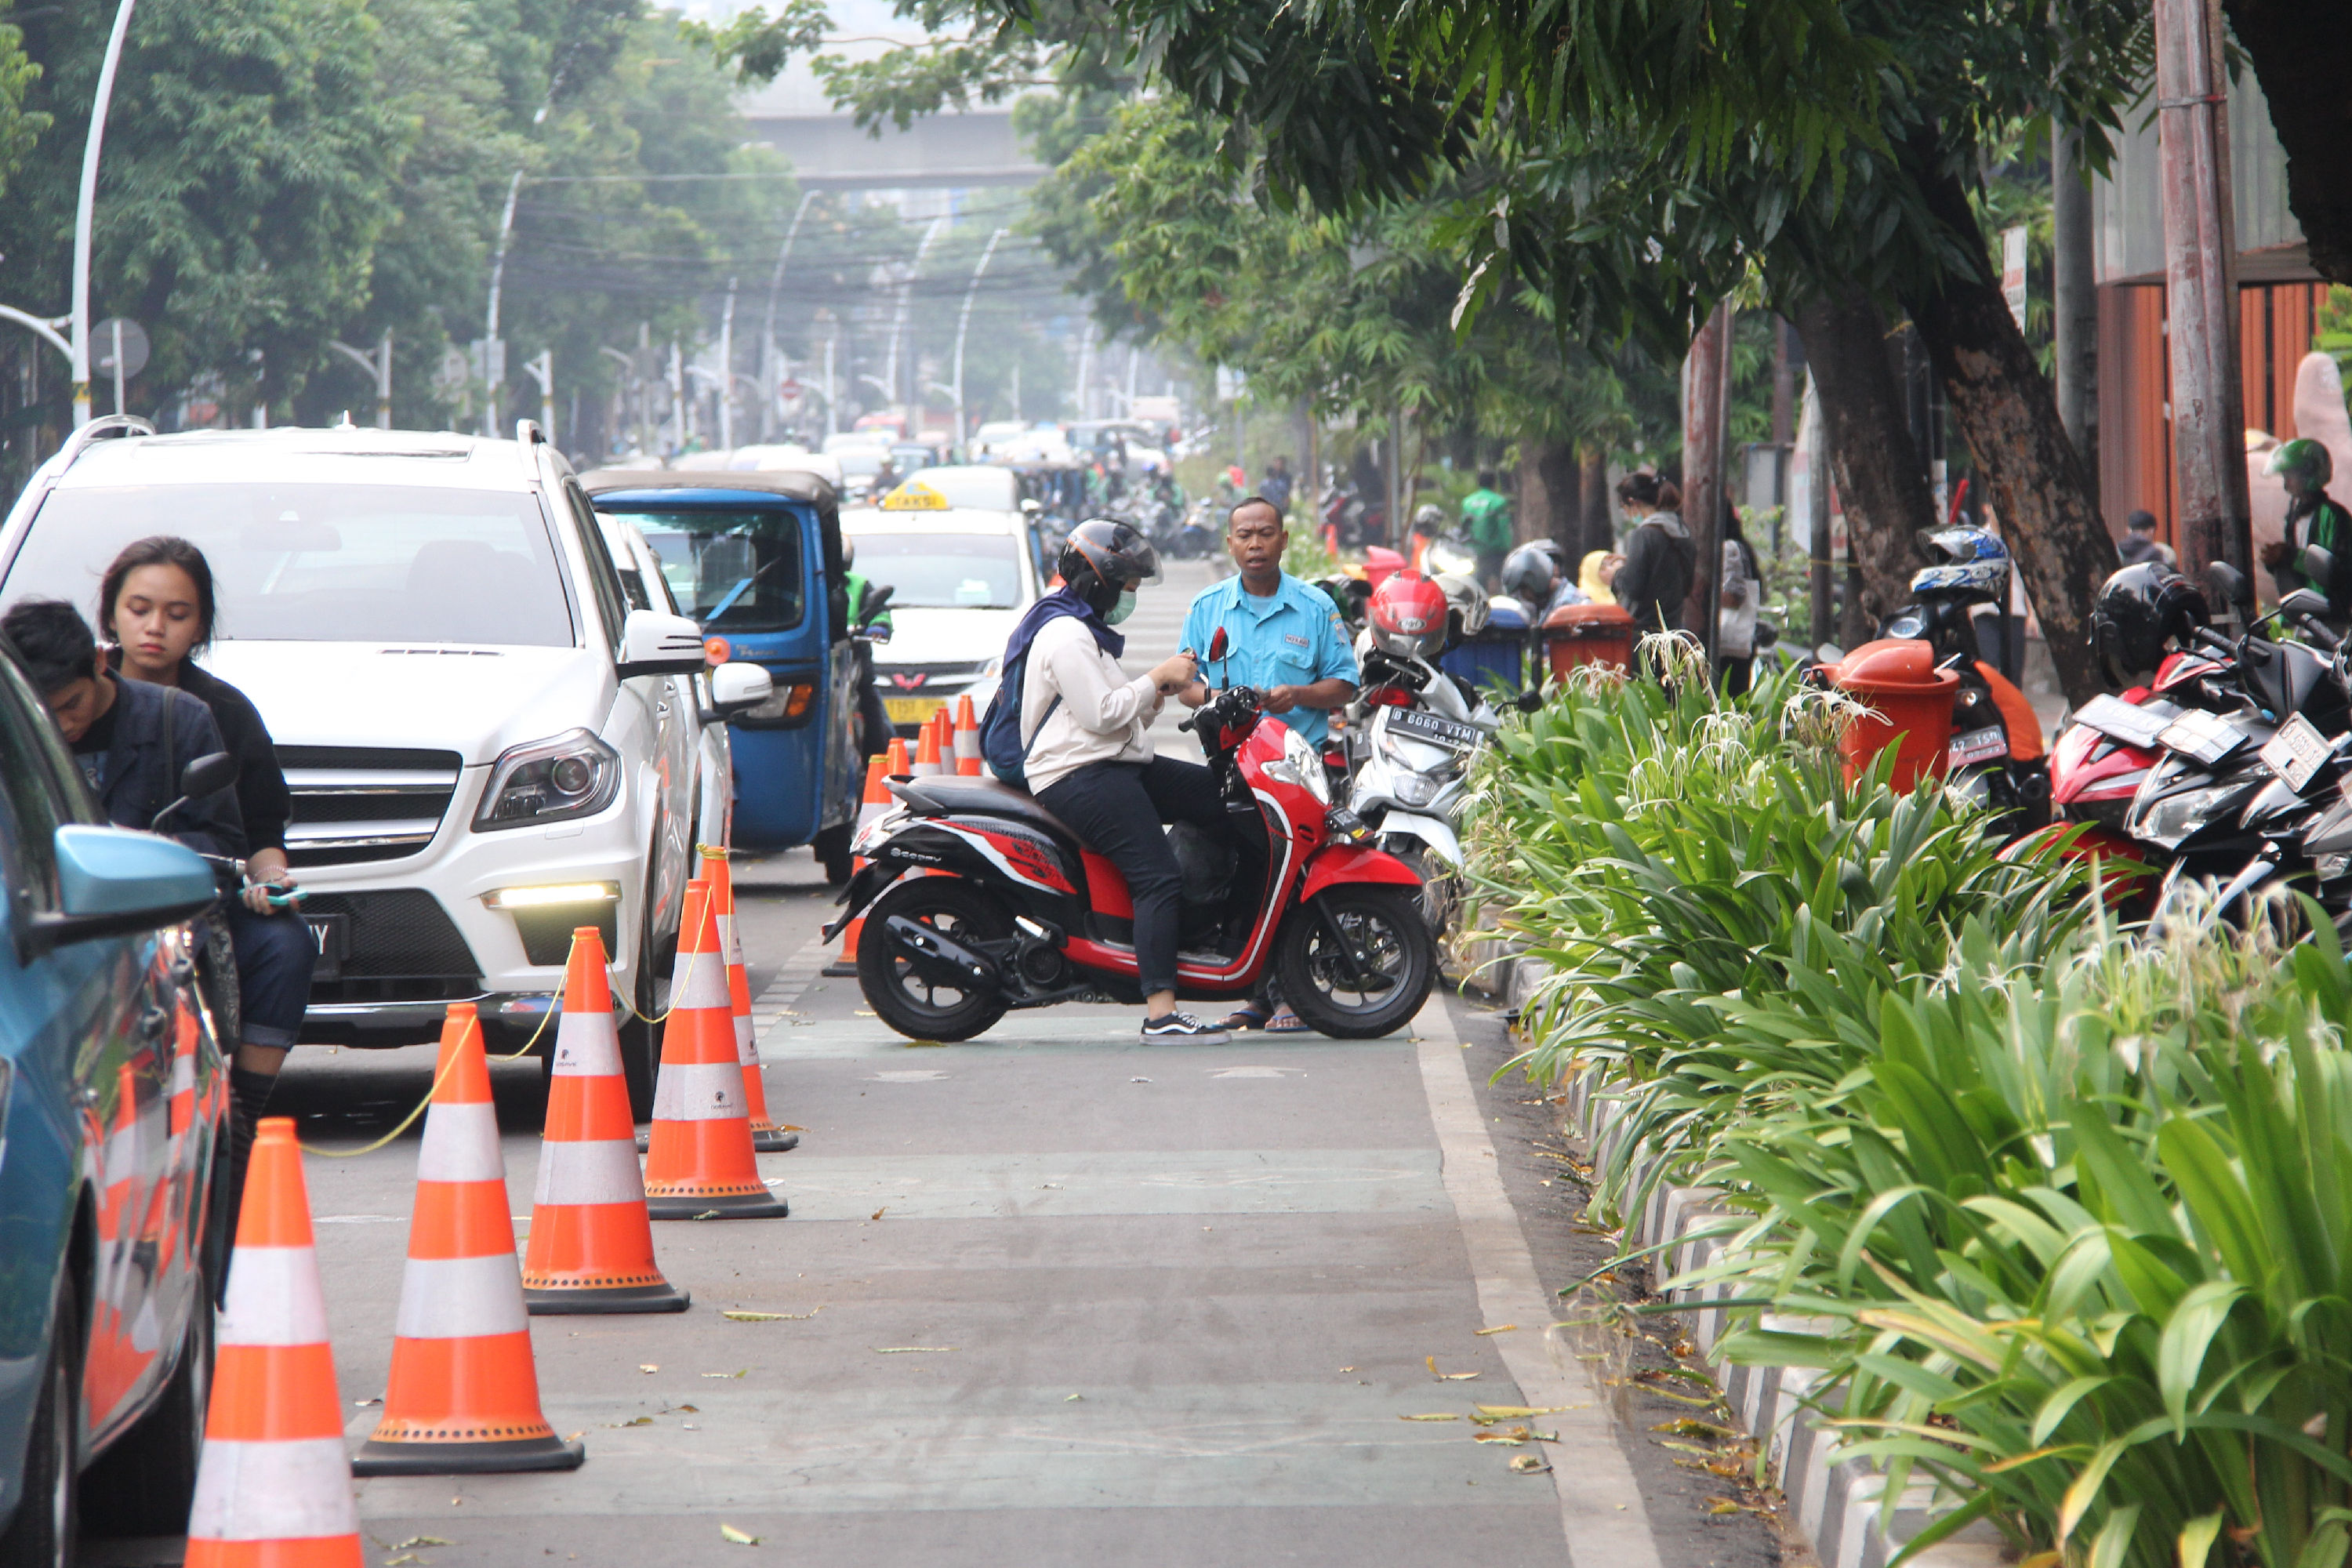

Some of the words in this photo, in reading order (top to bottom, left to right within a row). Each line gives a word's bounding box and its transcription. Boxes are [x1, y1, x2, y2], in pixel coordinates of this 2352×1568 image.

[894, 495, 937, 507] TAKSI
[1394, 711, 1403, 720] B
[1407, 713, 1439, 730] 6060
[1447, 724, 1472, 740] VTM
